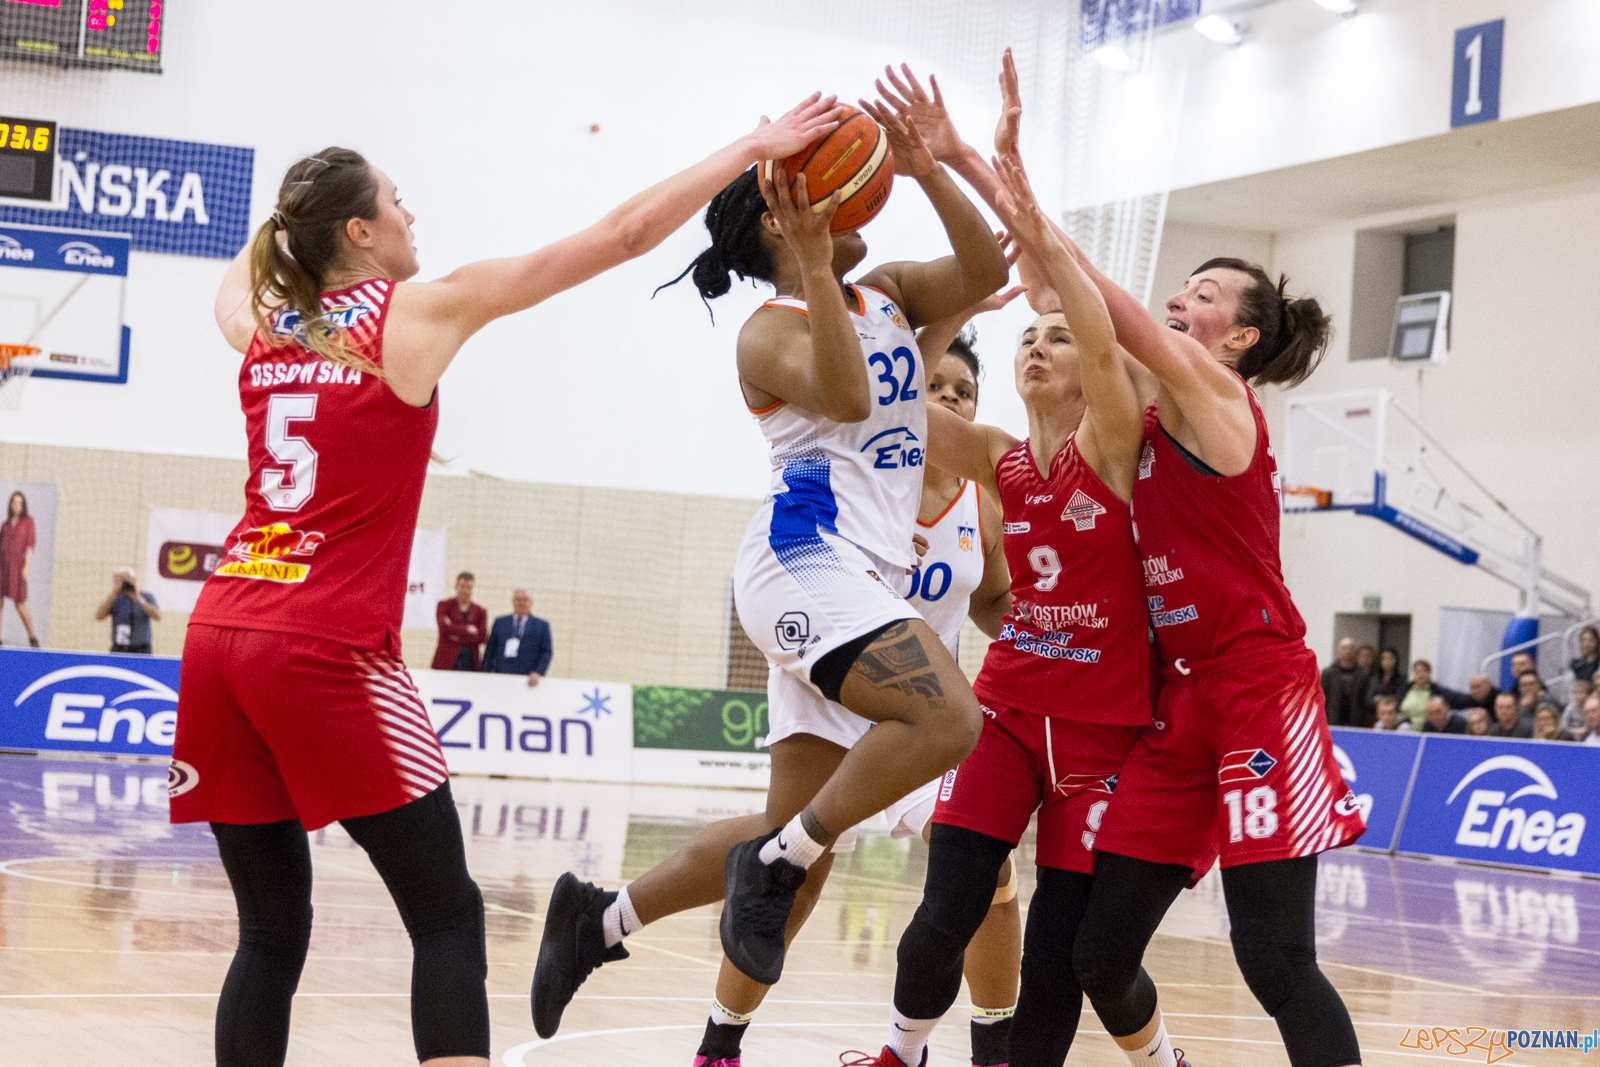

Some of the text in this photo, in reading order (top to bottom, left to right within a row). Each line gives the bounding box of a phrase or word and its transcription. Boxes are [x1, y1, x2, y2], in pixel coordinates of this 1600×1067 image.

[1464, 33, 1483, 116] 1
[866, 186, 887, 212] FIBA
[64, 248, 115, 268] Enea
[868, 346, 918, 406] 32
[259, 393, 319, 512] 5
[1027, 545, 1062, 592] 9
[1034, 602, 1097, 622] OSTRÓW
[1016, 640, 1100, 662] OSTROWSKI
[1223, 785, 1279, 844] 18
[1455, 789, 1586, 857] Enea
